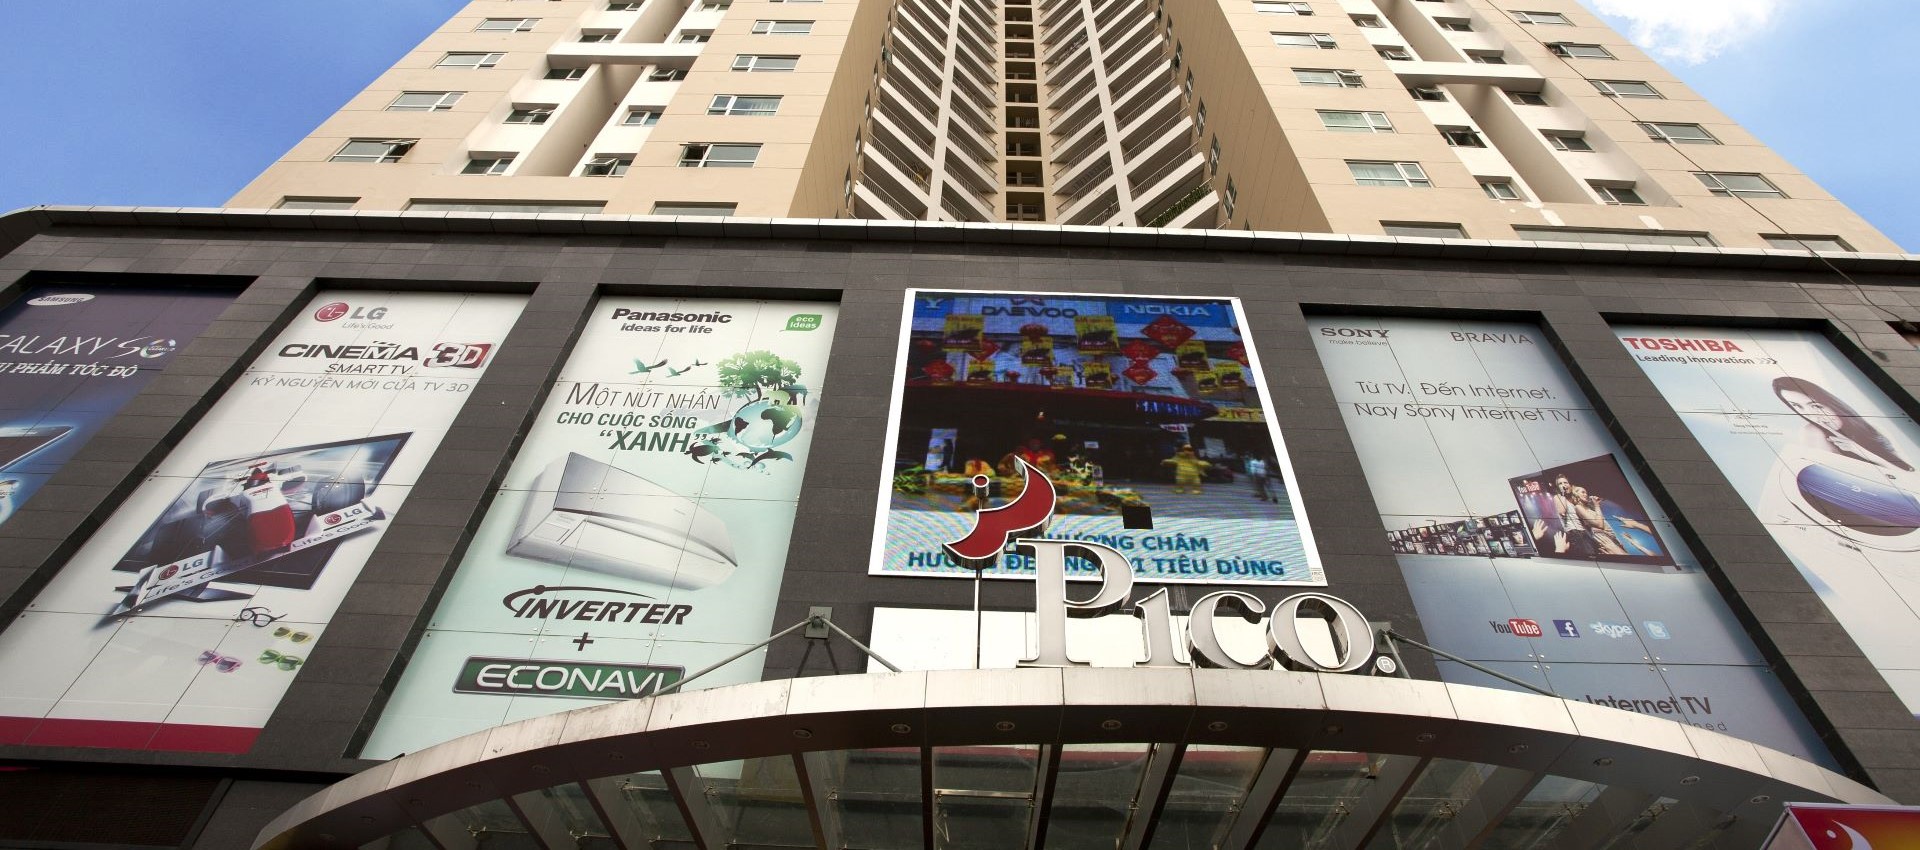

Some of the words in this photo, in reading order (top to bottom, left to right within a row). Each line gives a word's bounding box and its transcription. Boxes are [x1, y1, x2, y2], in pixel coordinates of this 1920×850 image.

[350, 306, 388, 320] LG
[611, 308, 733, 324] Panasonic
[981, 305, 1079, 319] DAEWOO
[1124, 304, 1212, 317] NOKIA
[620, 322, 660, 333] ideas
[664, 323, 687, 333] for
[689, 324, 713, 334] life
[789, 321, 817, 330] ideas
[1320, 327, 1390, 339] SONY
[1449, 331, 1535, 345] BRAVIA
[1622, 337, 1745, 353] TOSHIBA
[277, 341, 420, 361] CINEMA
[423, 343, 491, 369] 3D
[1635, 354, 1688, 365] Leading
[1689, 355, 1755, 366] Innovation
[325, 363, 389, 376] SMART
[390, 364, 414, 376] TV
[423, 381, 444, 392] TV
[445, 383, 470, 393] 3D
[622, 388, 665, 408] NÚT
[1353, 402, 1398, 420] Nay
[1403, 403, 1456, 421] Sony
[1461, 405, 1546, 422] Internet
[556, 410, 594, 426] CHO
[596, 411, 646, 429] CUỘC
[344, 508, 363, 518] LG
[182, 558, 204, 572] LG
[505, 594, 693, 626] INVERTER
[1014, 538, 1375, 673] Pico
[1488, 618, 1543, 638] YouTube
[1593, 621, 1632, 639] skype
[476, 663, 665, 695] ECONAVI
[1680, 696, 1713, 715] TV
